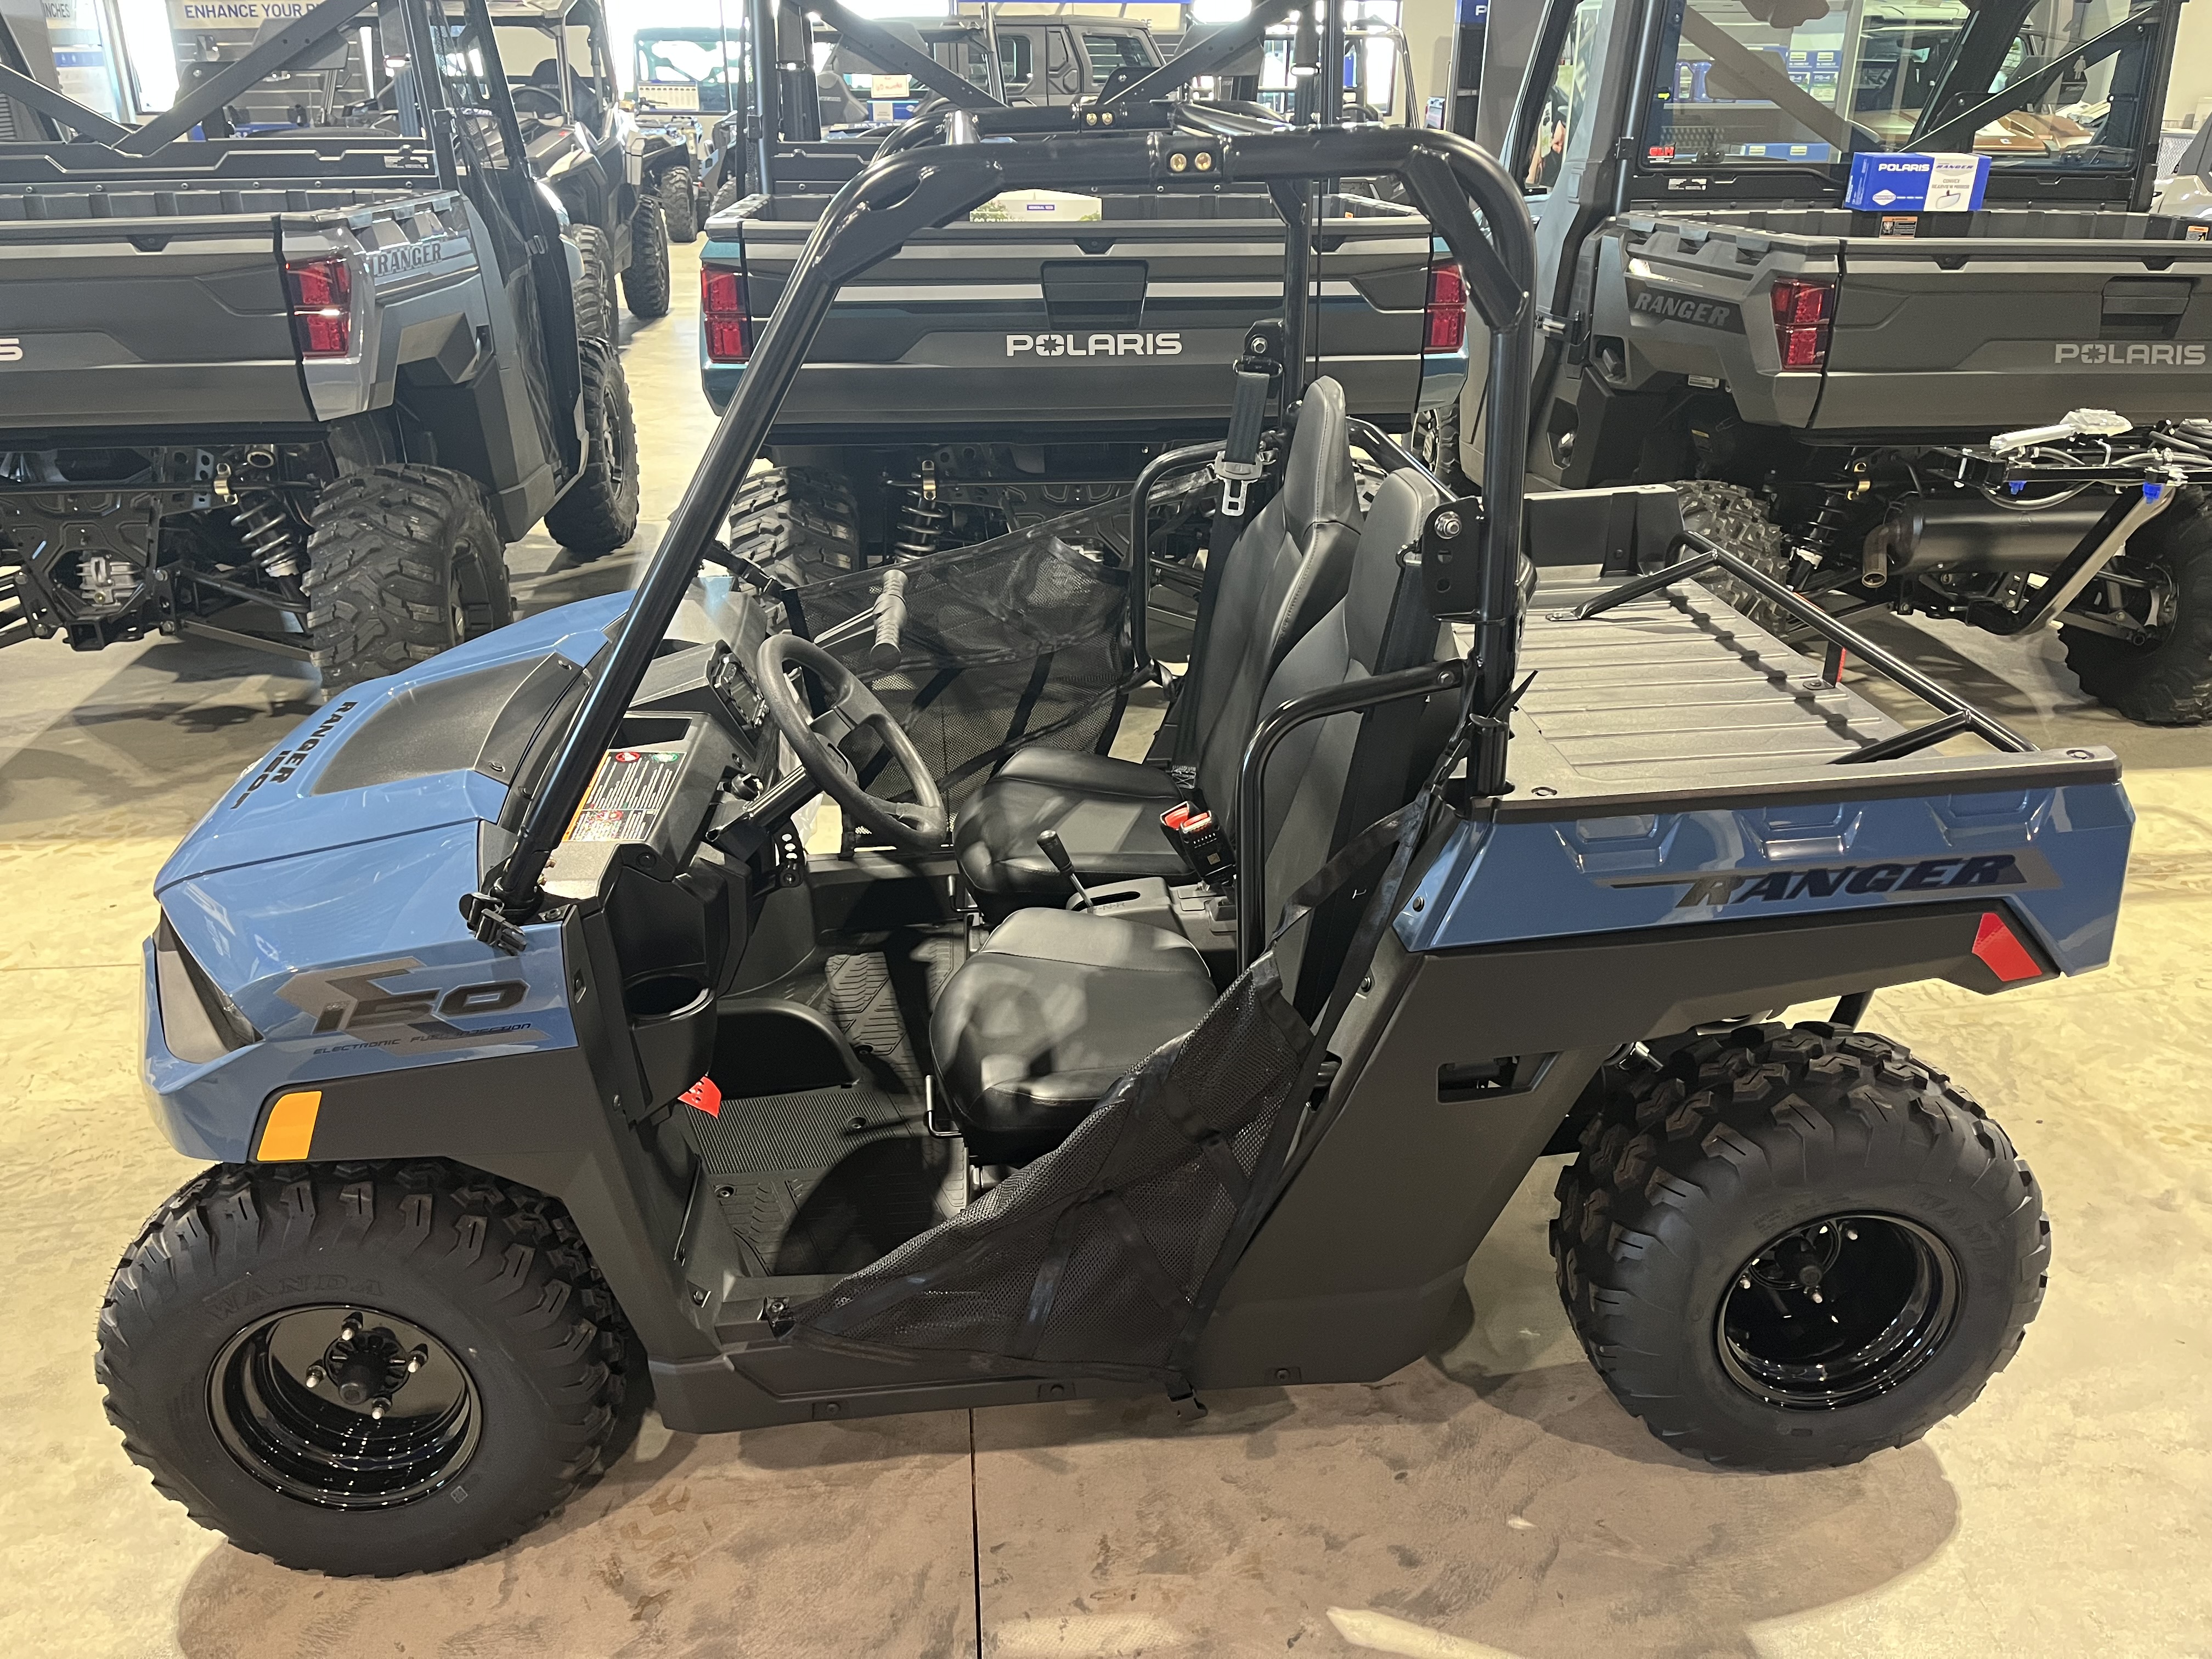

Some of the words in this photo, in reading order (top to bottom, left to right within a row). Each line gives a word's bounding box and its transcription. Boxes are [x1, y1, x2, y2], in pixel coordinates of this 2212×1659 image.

[184, 4, 259, 18] ENHANCE
[261, 3, 303, 17] YOUR
[1878, 163, 1930, 172] POLARIS
[378, 242, 442, 274] RANGER
[1634, 292, 1730, 326] RANGER
[1007, 333, 1183, 357] POLARIS
[2055, 343, 2206, 365] POLARIS
[269, 702, 358, 783] RANGER
[1676, 854, 2017, 909] RANGER
[313, 1039, 402, 1054] ELECTRONIC
[410, 1032, 447, 1043] FUEL
[457, 1023, 532, 1037] INJECTION
